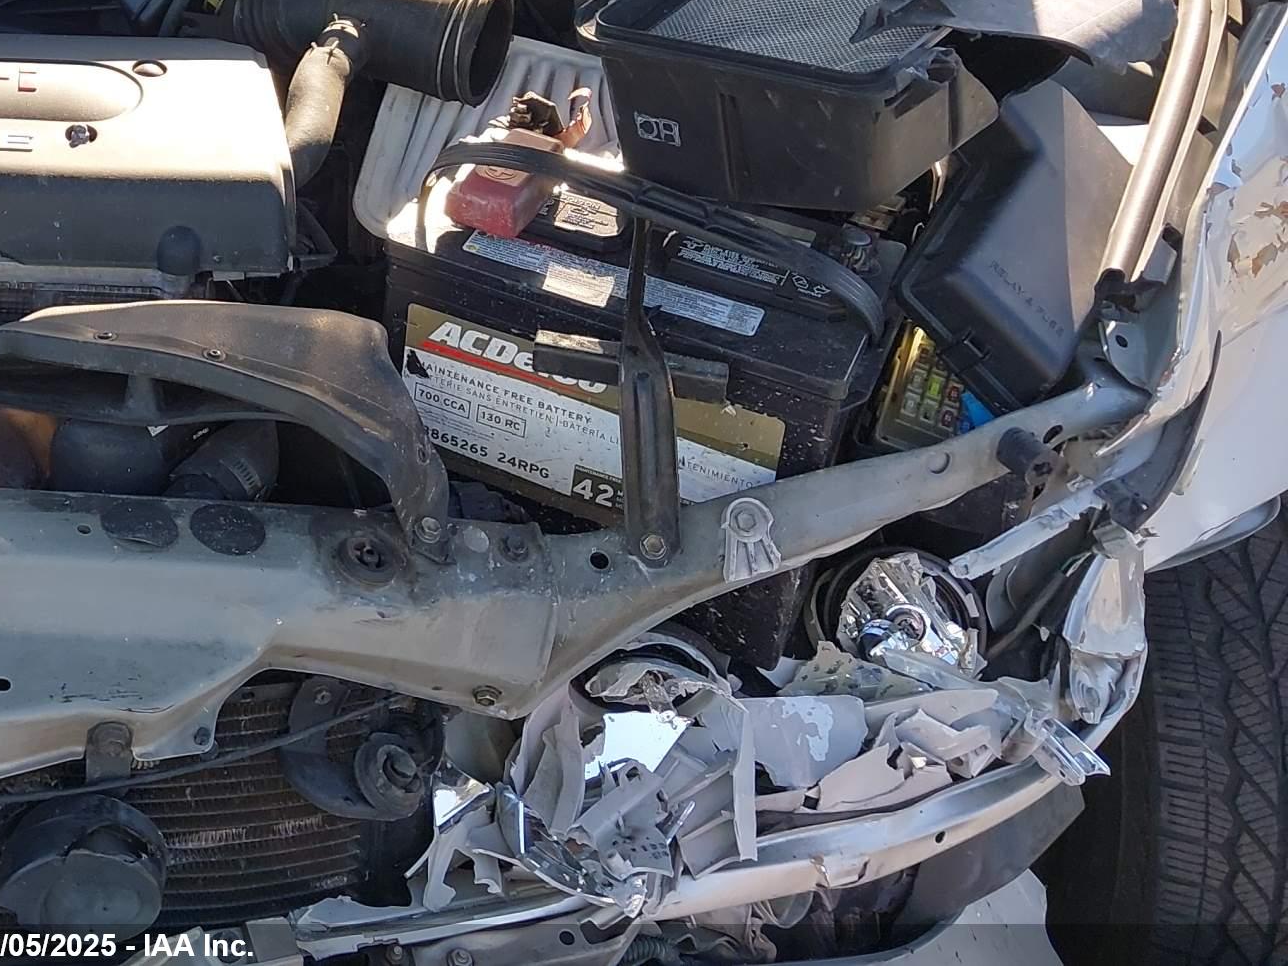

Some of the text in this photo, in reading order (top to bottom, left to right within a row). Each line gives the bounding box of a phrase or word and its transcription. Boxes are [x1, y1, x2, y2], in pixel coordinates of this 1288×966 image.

[418, 388, 466, 413] 700 CCA
[465, 387, 492, 402] SANS
[495, 397, 553, 424] ENTRETIEN
[503, 389, 533, 406] FREE
[537, 401, 591, 424] BATTERY
[481, 411, 501, 425] 130
[504, 419, 521, 431] RC
[497, 452, 550, 479] 24RPG
[573, 478, 614, 508] 42
